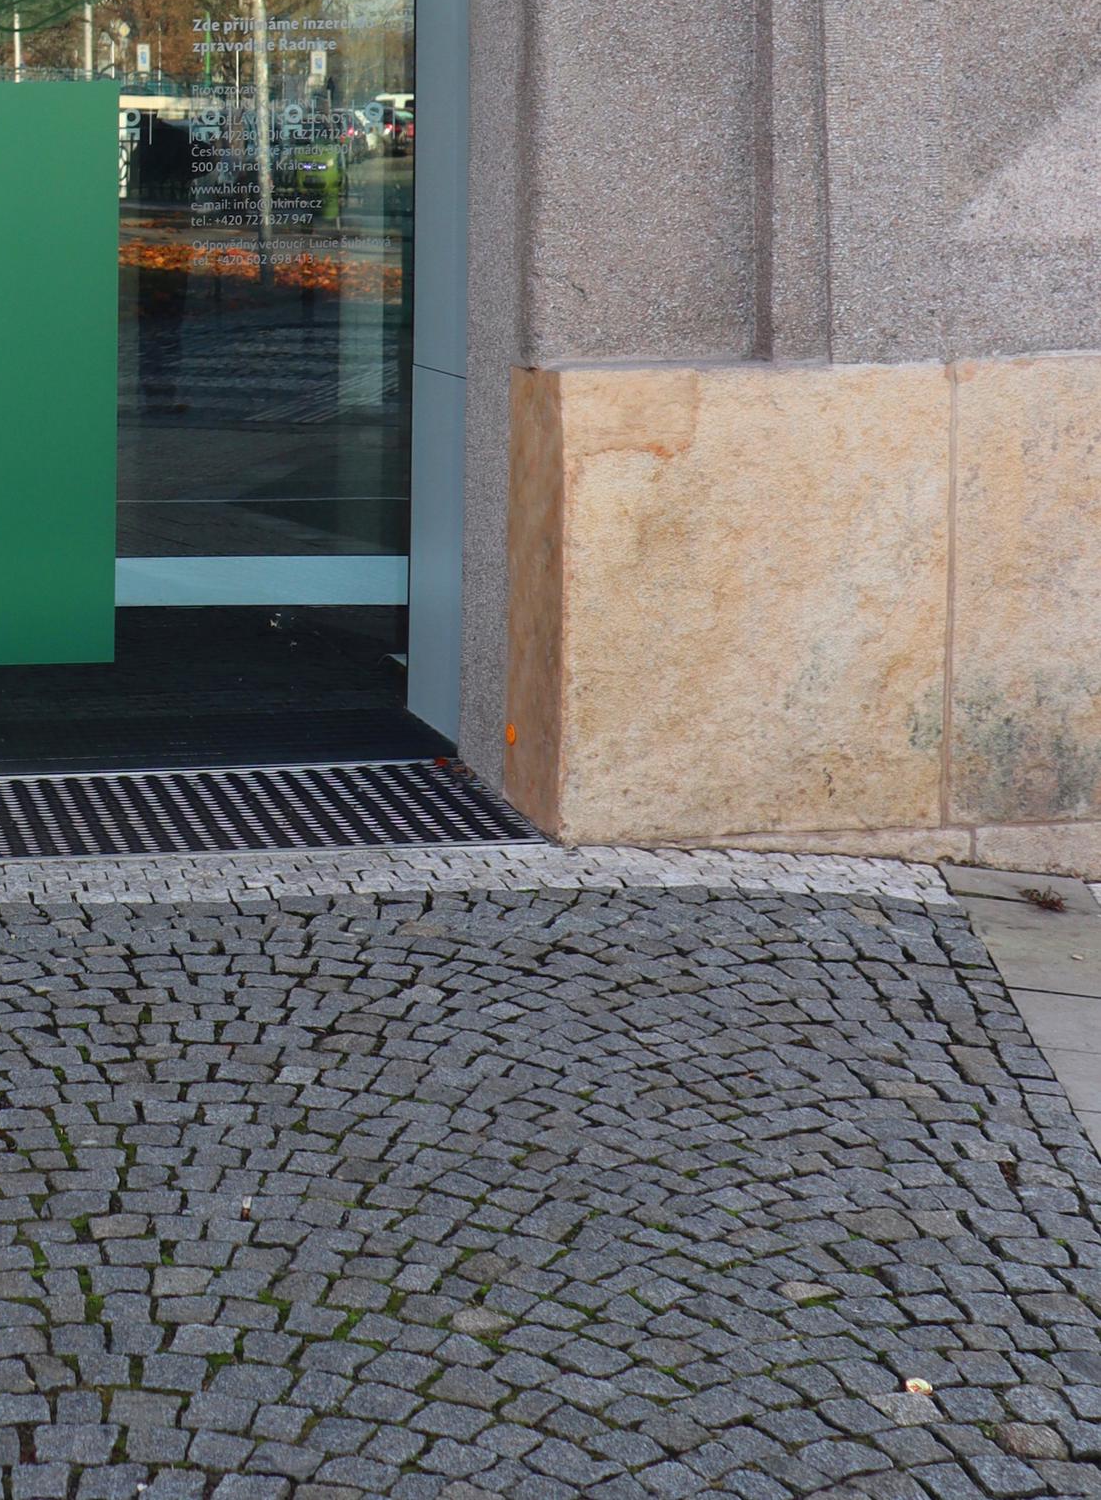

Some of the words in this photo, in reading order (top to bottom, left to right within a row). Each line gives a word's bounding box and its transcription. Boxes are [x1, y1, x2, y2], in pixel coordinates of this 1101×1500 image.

[193, 18, 219, 32] Zde
[278, 36, 338, 51] Radnice
[210, 129, 264, 141] 2747280
[192, 143, 280, 158] Českoslovenké
[283, 142, 324, 157] armády
[192, 161, 213, 173] 500
[215, 161, 230, 173] 03
[232, 160, 273, 172] Hradc
[190, 181, 276, 195] www.hkinfoz
[190, 198, 231, 211] e-mail:
[233, 196, 323, 212] info@hkinfo.cz
[190, 214, 212, 227] tel.:
[214, 214, 243, 227] +420
[245, 214, 265, 226] 727
[269, 213, 289, 225] 827
[291, 212, 314, 225] 947
[193, 238, 257, 253] Odpovědný
[308, 236, 340, 249] Lucie
[216, 255, 244, 267] +420
[246, 254, 268, 266] 602
[269, 253, 292, 265] 698
[293, 252, 315, 265] 413
